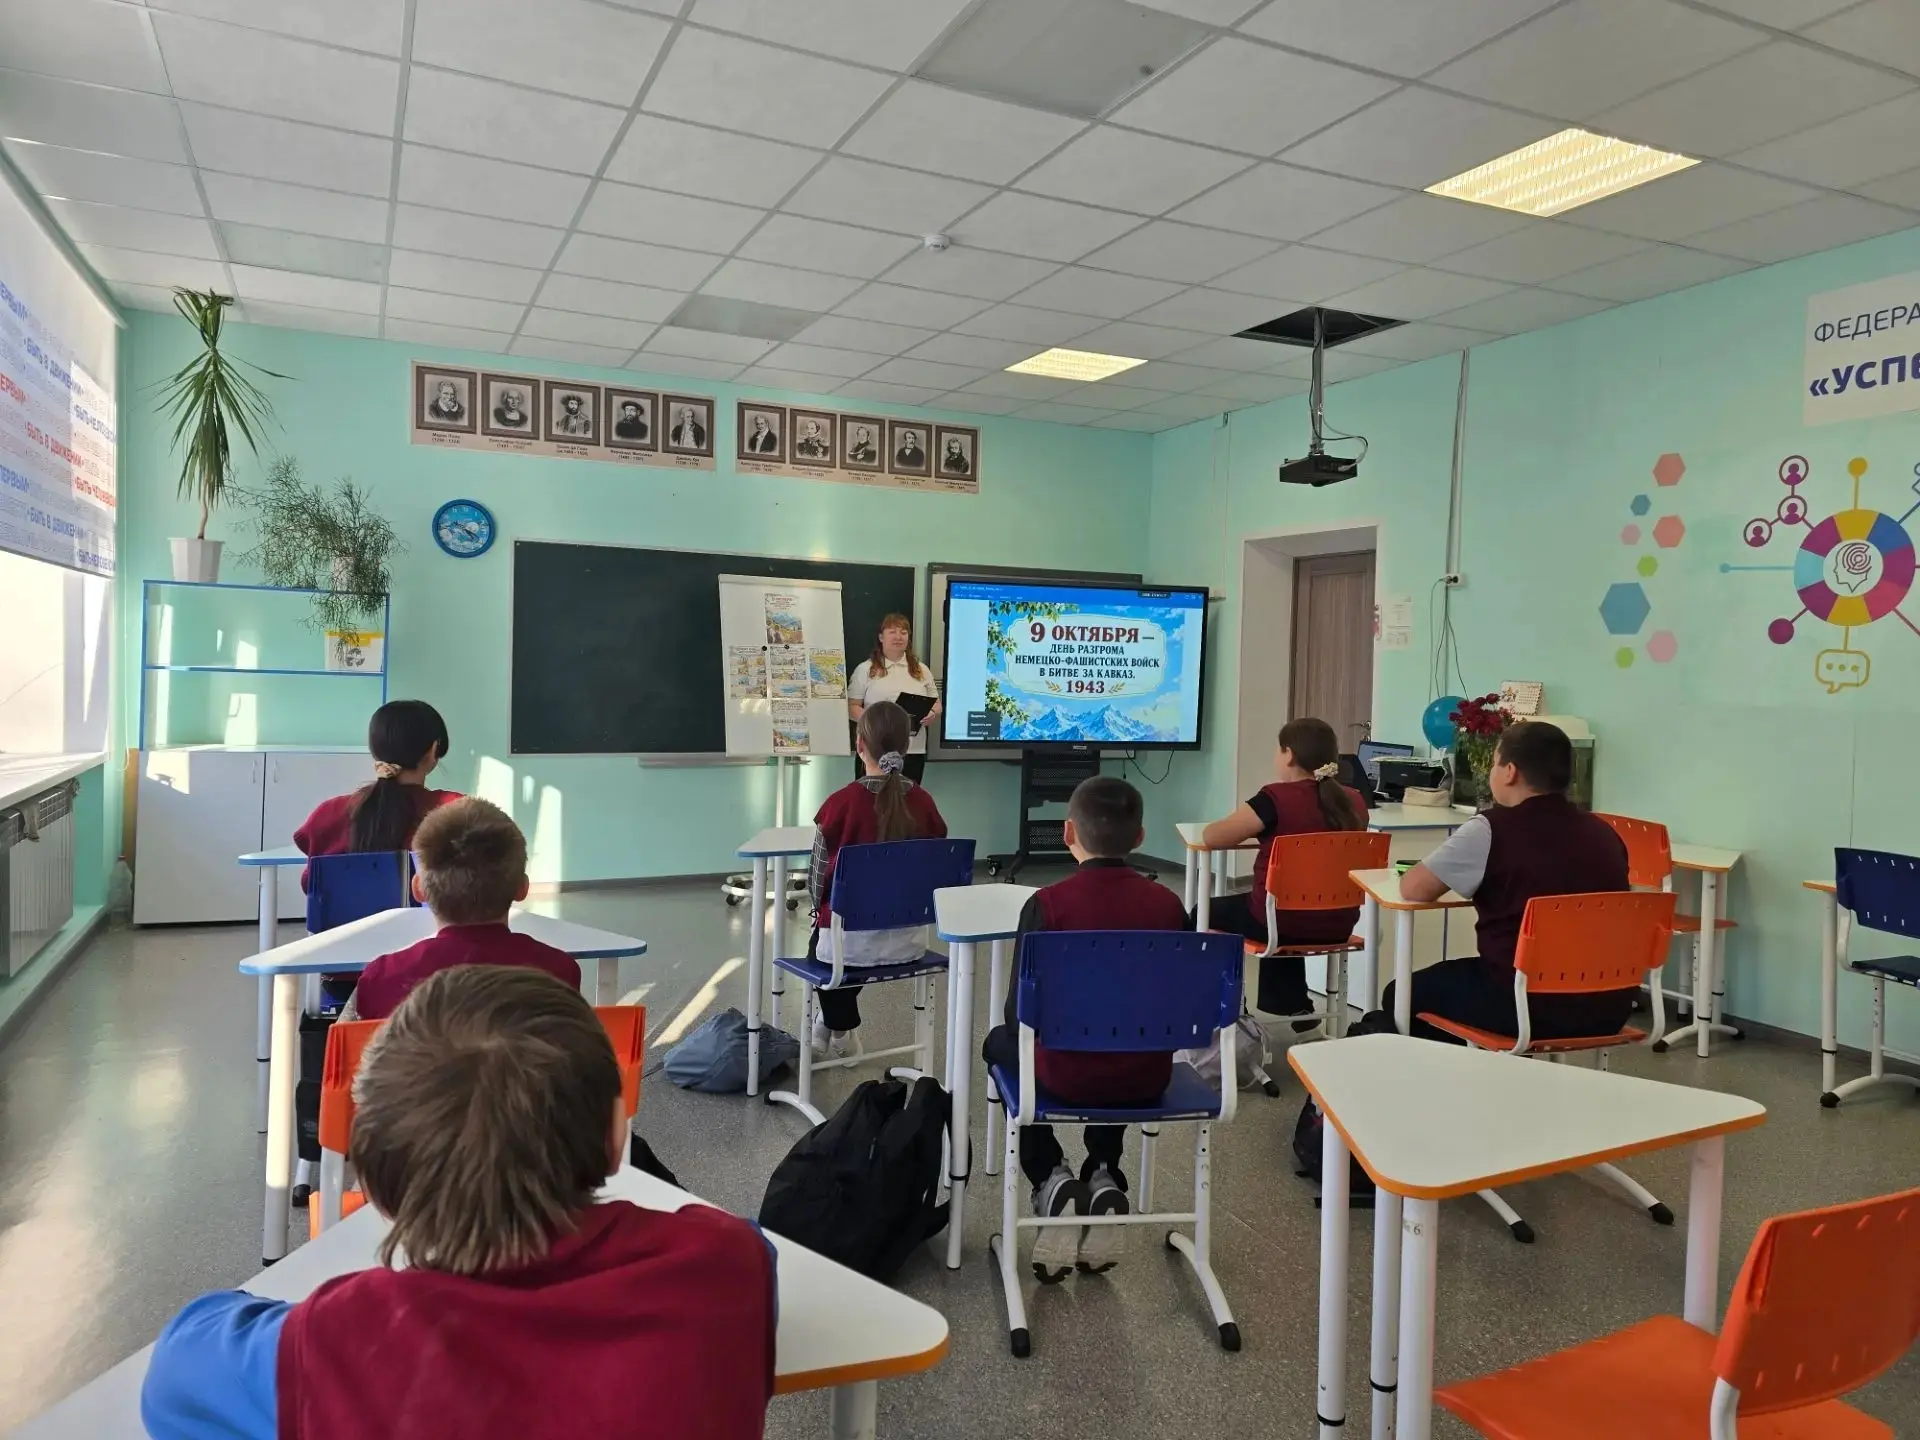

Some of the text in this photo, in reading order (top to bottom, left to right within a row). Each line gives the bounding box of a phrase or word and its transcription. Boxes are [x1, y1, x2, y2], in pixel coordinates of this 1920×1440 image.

[1030, 622, 1046, 643] 9
[1051, 625, 1140, 643] ОКТЯБРЯ
[1050, 644, 1125, 655] ДЕНЬ РАЗГРОМА
[1015, 655, 1160, 668] НЕМЕЦКО-ФАШИСТСКИХ ВОЙСК
[1039, 667, 1136, 679] В БИТВЕ ЗА КАВКАЗ.
[1066, 680, 1105, 694] 1943
